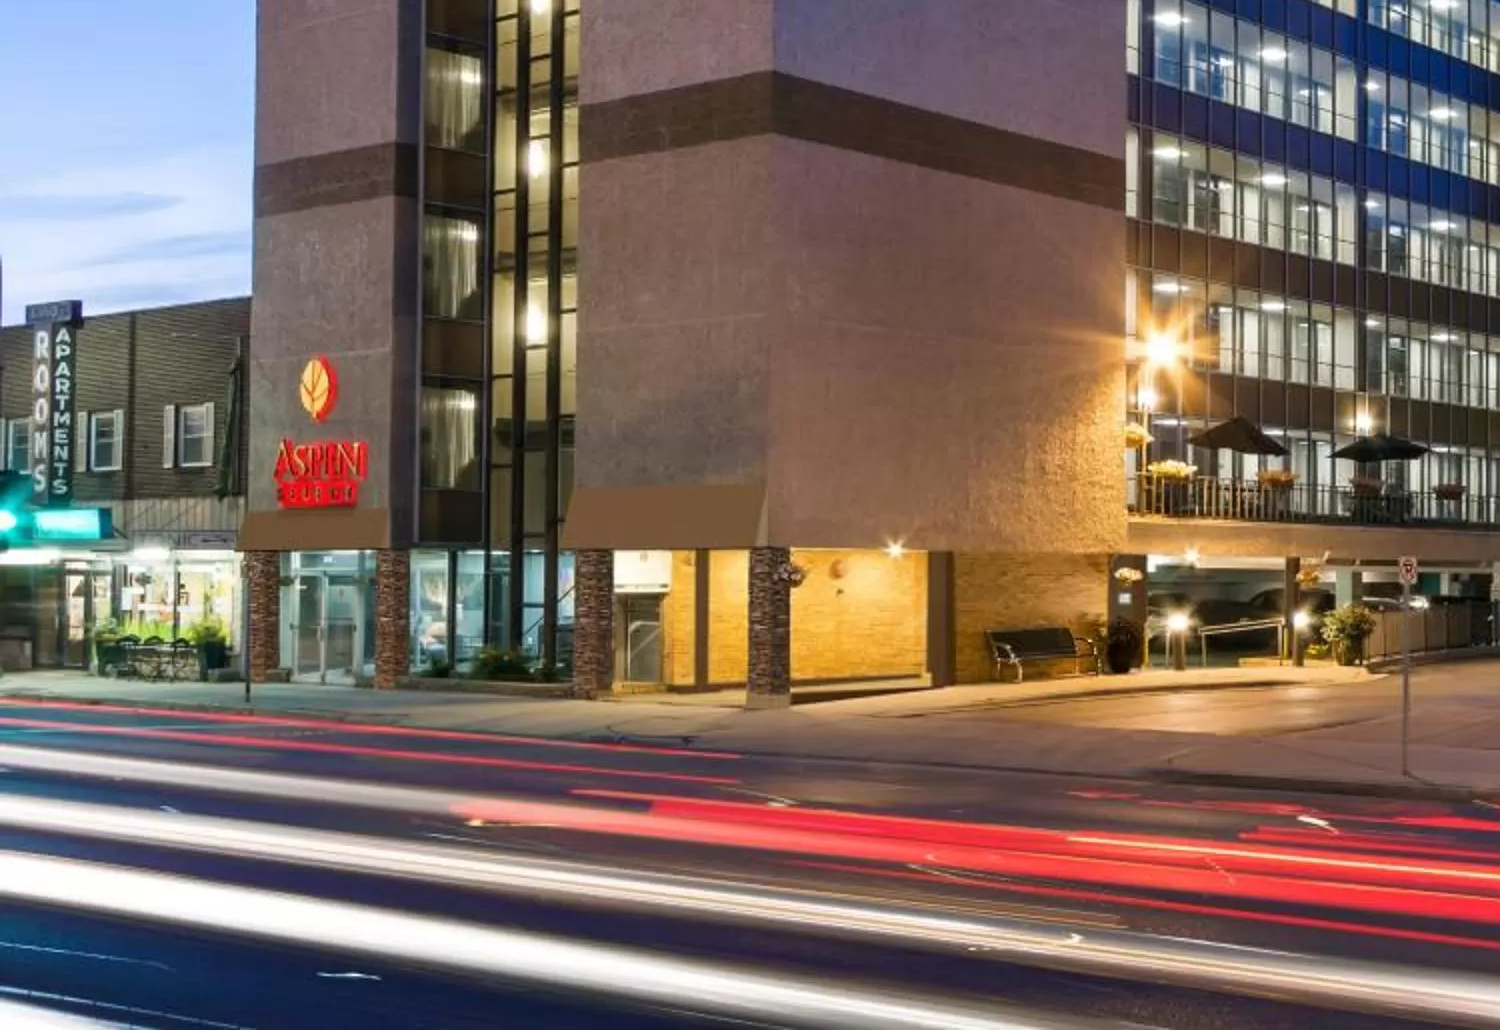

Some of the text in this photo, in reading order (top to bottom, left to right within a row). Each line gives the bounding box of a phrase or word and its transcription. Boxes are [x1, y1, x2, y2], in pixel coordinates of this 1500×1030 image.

[34, 330, 49, 493] ROOMS
[53, 327, 71, 495] APARTMENTS
[273, 437, 368, 481] ASPEN
